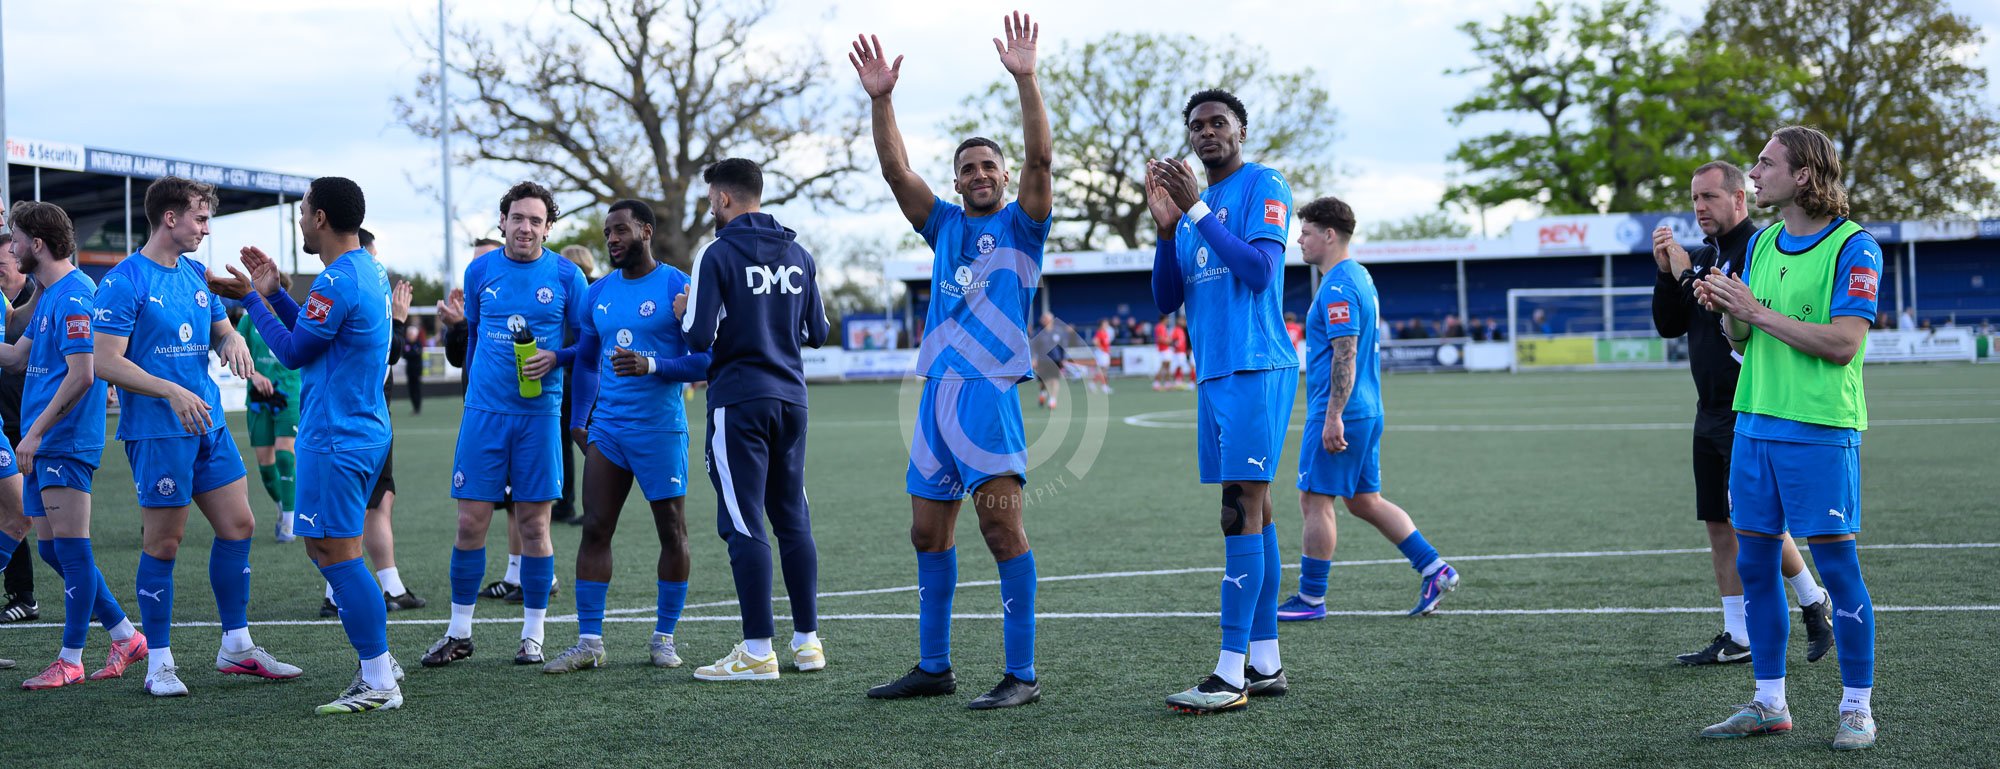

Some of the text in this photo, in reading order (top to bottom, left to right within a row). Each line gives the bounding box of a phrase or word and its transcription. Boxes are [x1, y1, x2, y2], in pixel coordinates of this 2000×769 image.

[39, 143, 78, 167] Security
[91, 150, 133, 173] INTRUDER
[133, 156, 168, 178] ALARMS
[745, 265, 804, 295] DMC
